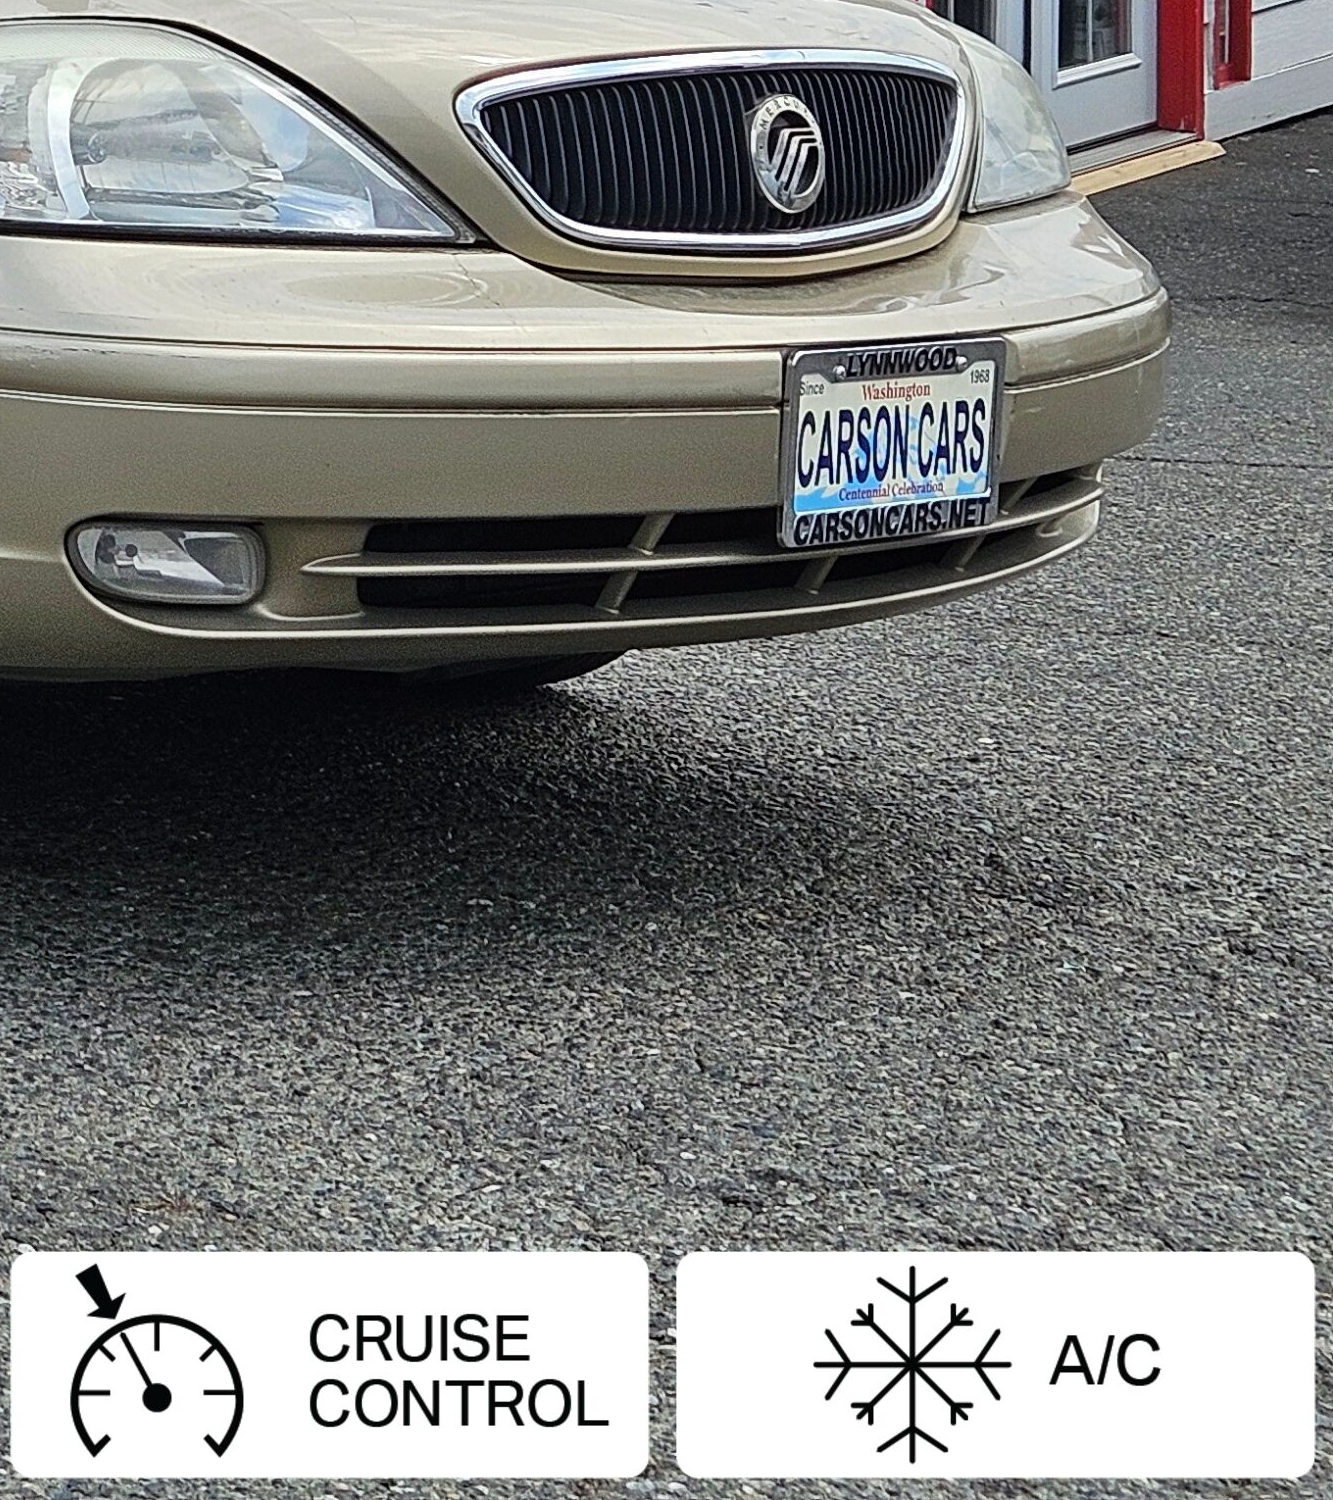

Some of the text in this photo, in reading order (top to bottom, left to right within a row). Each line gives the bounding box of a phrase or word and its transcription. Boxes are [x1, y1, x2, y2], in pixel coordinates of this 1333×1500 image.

[845, 346, 958, 378] LYNNWOOD
[799, 380, 825, 397] Since
[862, 383, 931, 402] Washington
[796, 397, 986, 489] CARSON CARS
[838, 481, 944, 502] Centennial Celebration
[793, 495, 991, 547] CARSONCARS.NET
